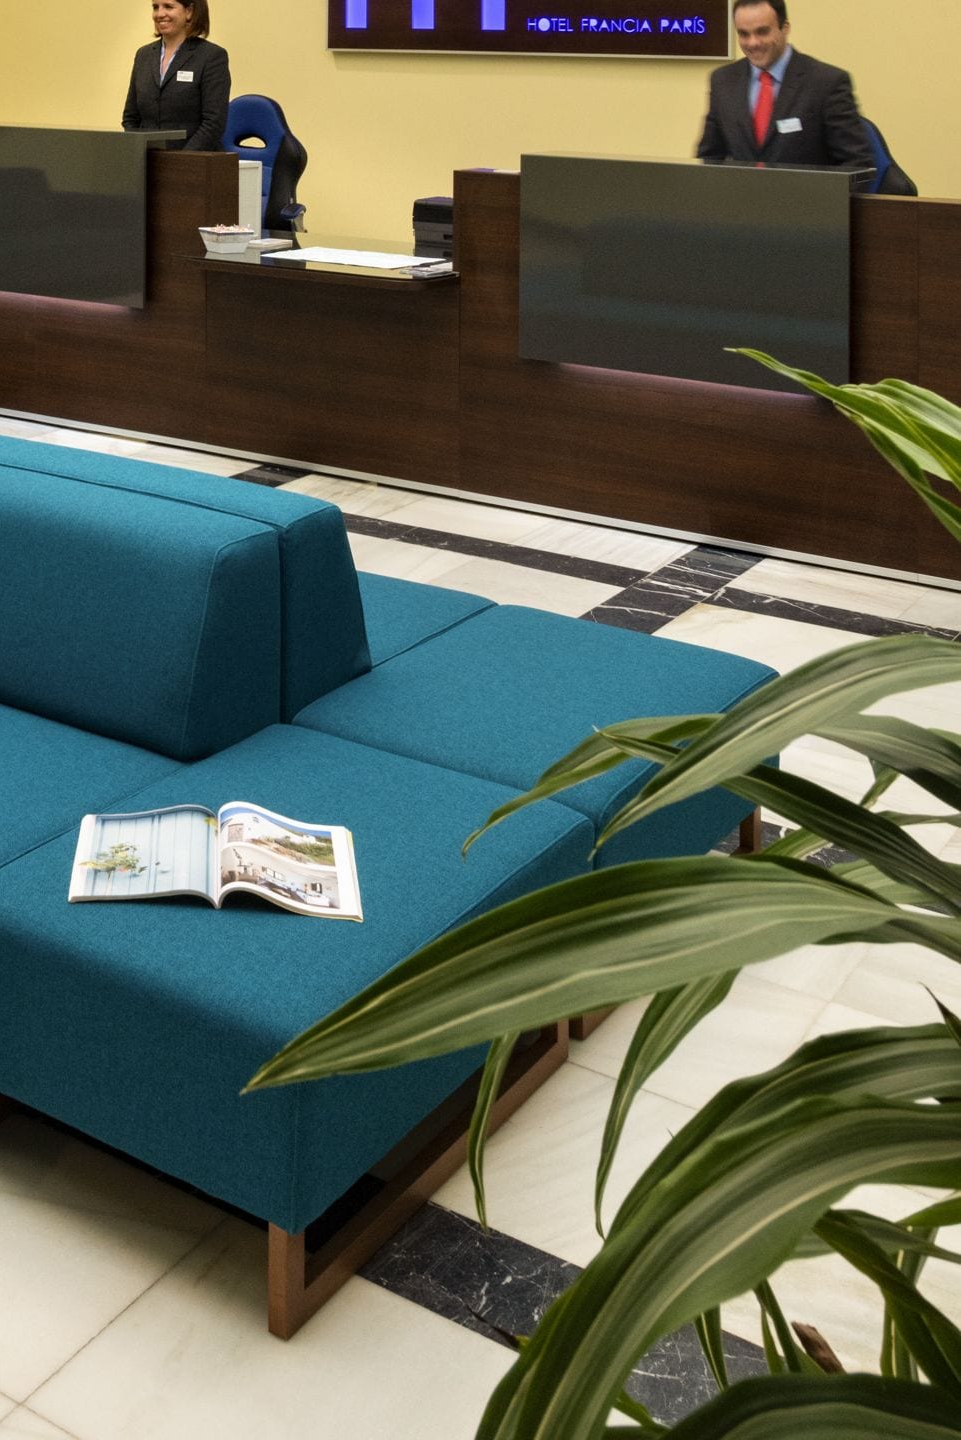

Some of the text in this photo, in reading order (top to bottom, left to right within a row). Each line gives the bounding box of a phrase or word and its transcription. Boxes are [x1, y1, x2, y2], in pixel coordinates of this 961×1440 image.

[526, 15, 706, 34] HOTEL FRANCIA PARÍS
